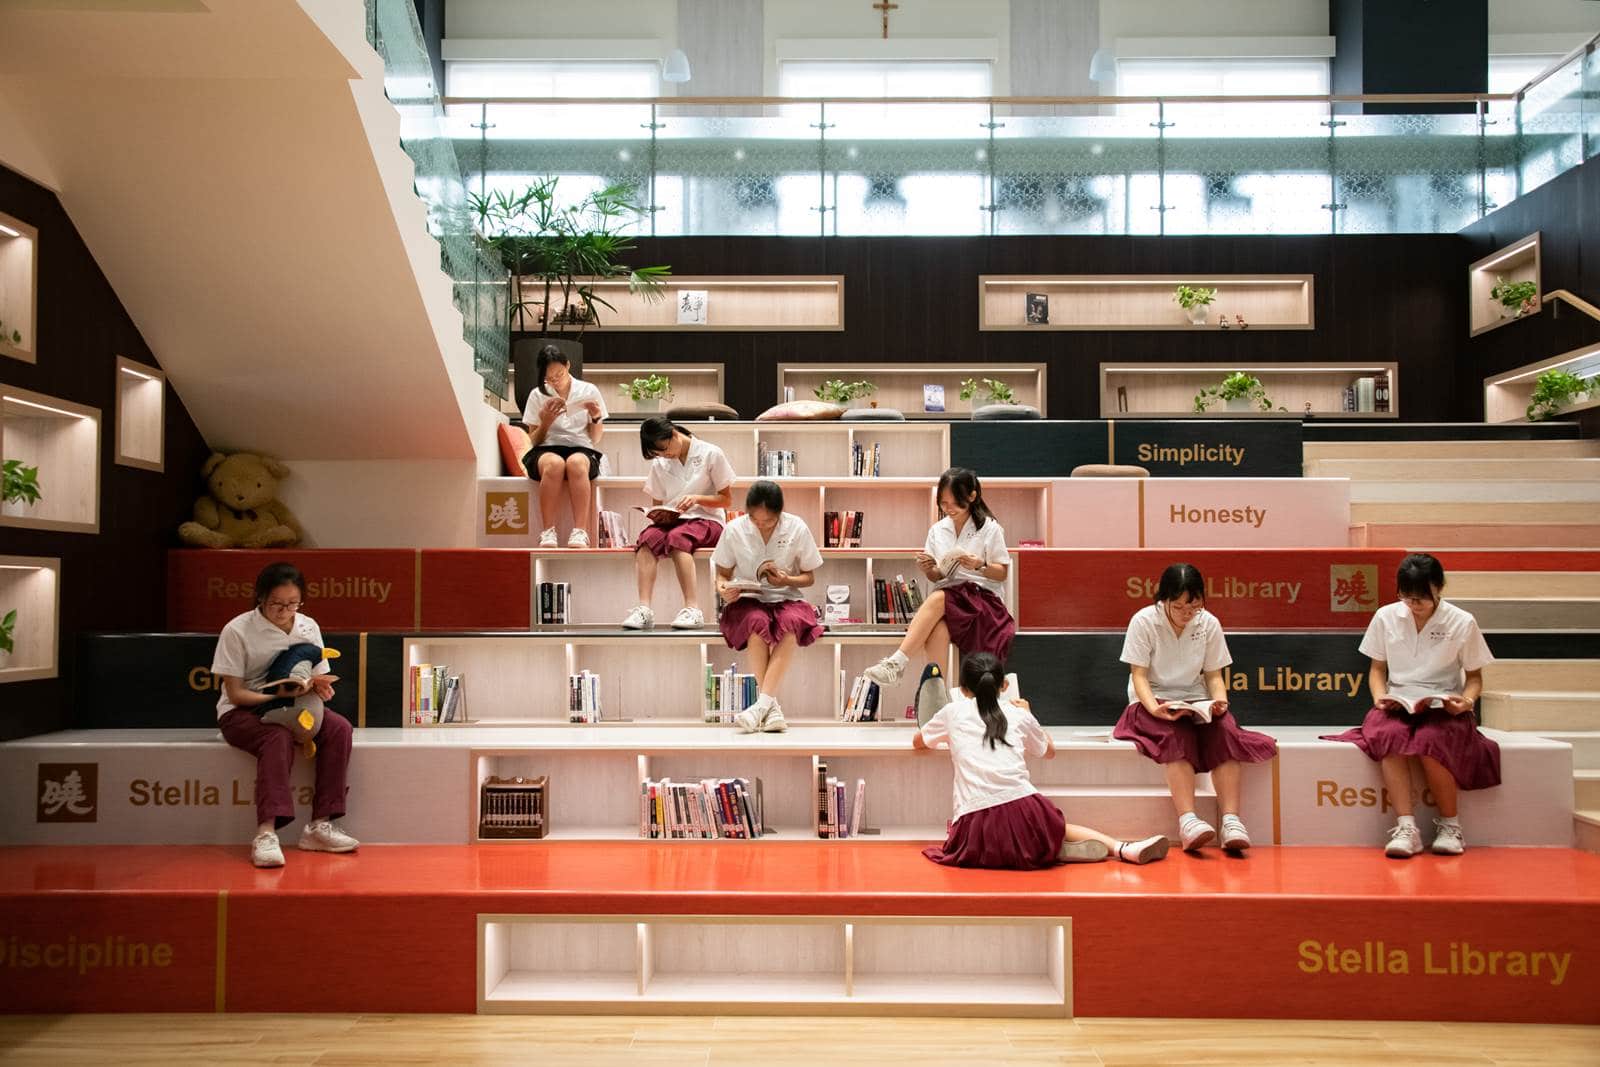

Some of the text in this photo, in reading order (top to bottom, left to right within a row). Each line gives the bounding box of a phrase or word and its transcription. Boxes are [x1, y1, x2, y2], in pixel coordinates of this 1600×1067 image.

[1137, 443, 1245, 466] Simplicity
[1170, 504, 1267, 528] Honesty
[207, 577, 393, 603] Ressibility
[1208, 577, 1302, 603] Library
[1258, 666, 1363, 697] Library
[128, 779, 220, 806] Stella
[1316, 780, 1439, 813] Respc
[0, 935, 173, 975] iscipline
[1297, 940, 1571, 985] Stella Library
